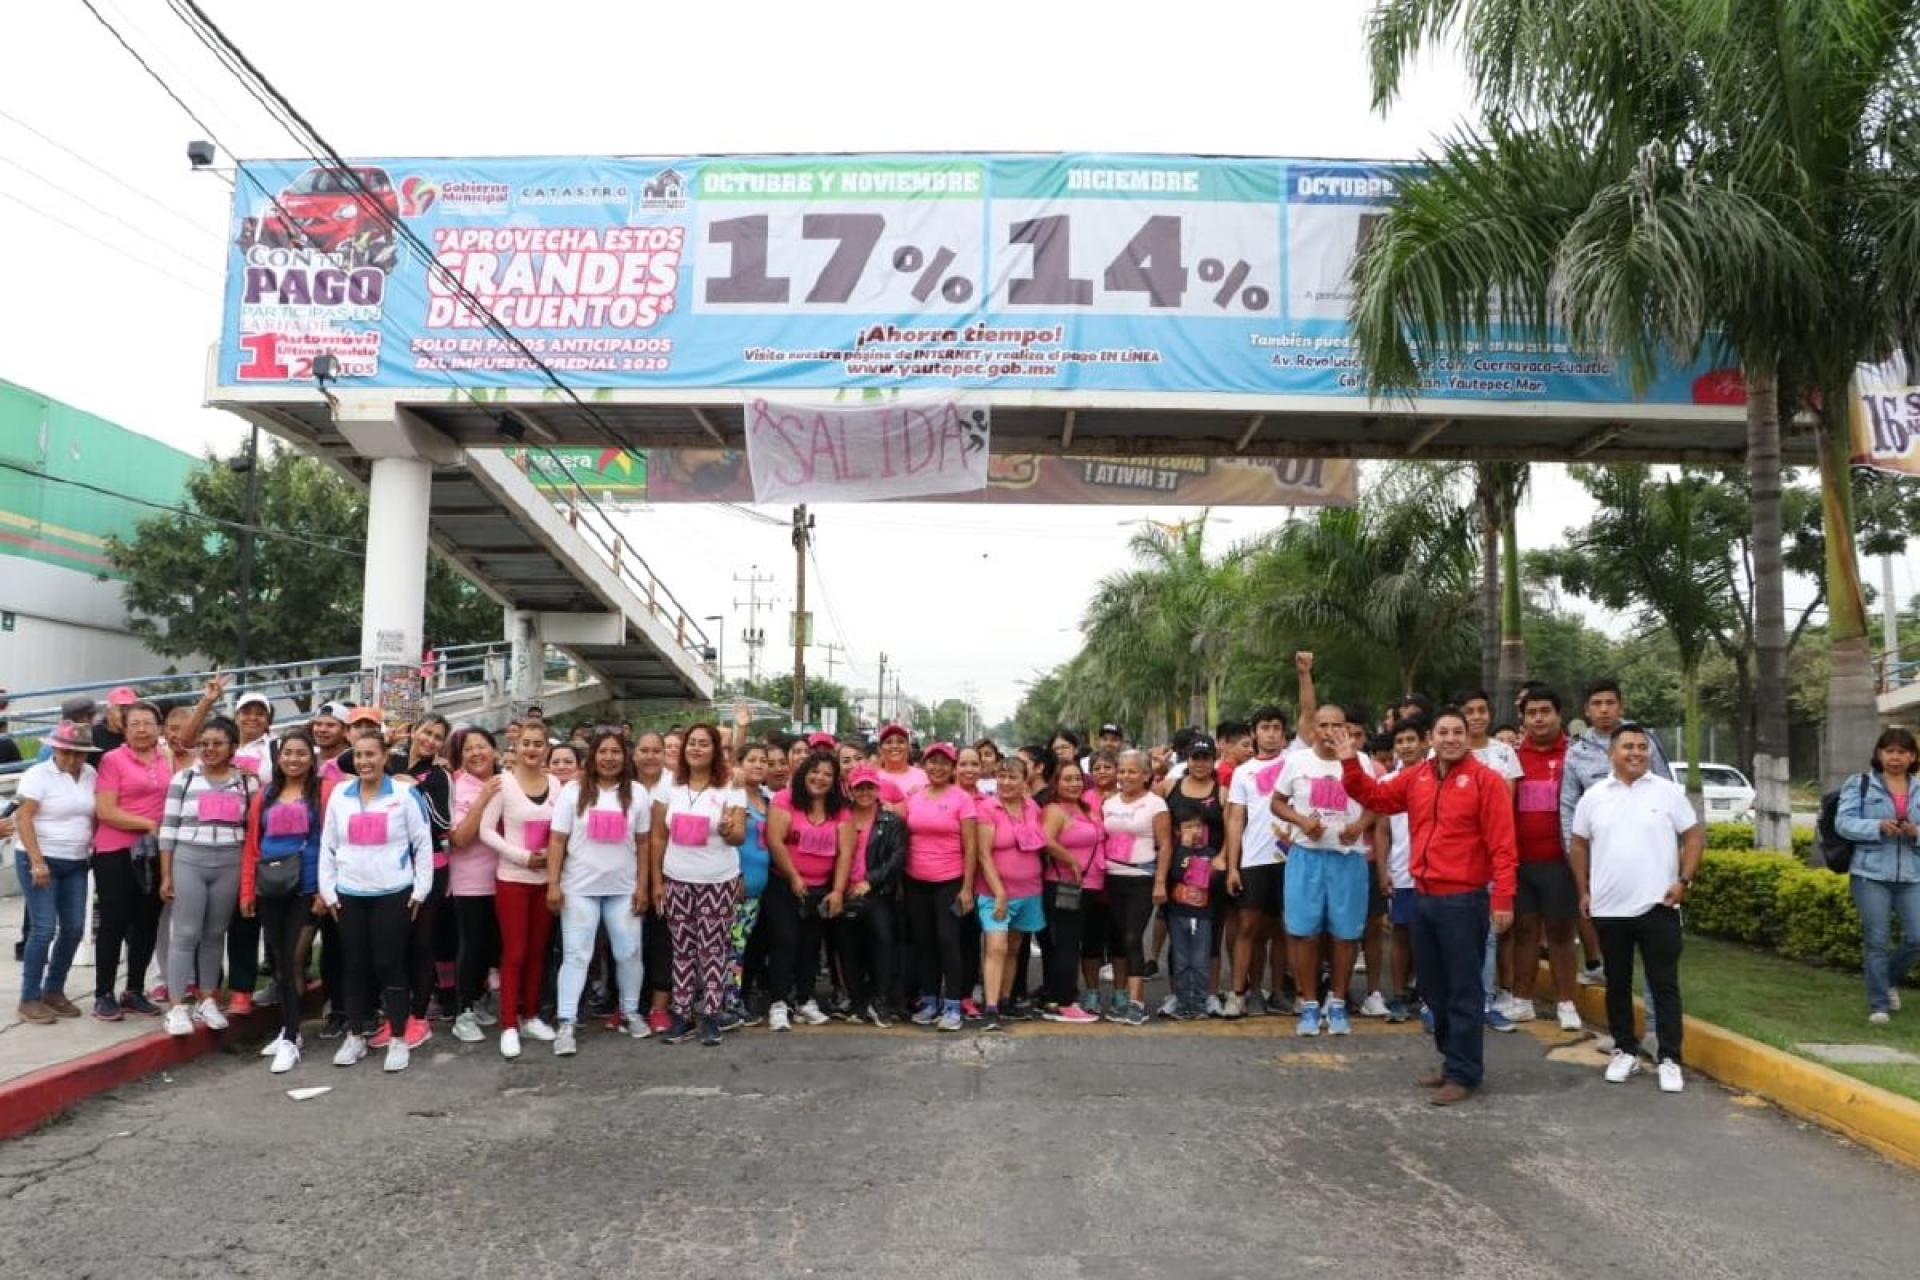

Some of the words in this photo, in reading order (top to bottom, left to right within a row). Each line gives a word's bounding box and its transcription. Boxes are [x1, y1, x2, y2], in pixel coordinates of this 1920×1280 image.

[705, 171, 812, 193] OCTUBRE
[819, 172, 834, 193] Y
[841, 171, 979, 193] NOVIEMBRE
[1068, 170, 1199, 192] DICIEMBRE
[522, 187, 627, 198] CATASTRO
[604, 228, 684, 250] ESTOS
[249, 246, 311, 266] CON
[706, 213, 974, 304] 17%
[1008, 214, 1270, 311] 14%
[428, 252, 680, 295] GRANDES
[244, 269, 382, 306] PAGO
[412, 339, 457, 351] SOLO
[460, 339, 482, 351] EN
[550, 339, 671, 351] ANTICIPADOS
[964, 323, 1063, 346] tiempo!
[240, 333, 288, 378] 1
[416, 358, 448, 369] DEL
[450, 358, 538, 369] IMPUESTO
[543, 357, 616, 369] PREDIAL
[620, 358, 668, 369] 2020
[745, 350, 785, 360] Visita
[914, 350, 981, 361] INTERNET
[1061, 351, 1097, 363] pago
[1100, 350, 1118, 361] EN
[847, 361, 1056, 378] www.yautepec.gob.mx
[1861, 394, 1910, 453] 16
[775, 401, 969, 486] SALIDA
